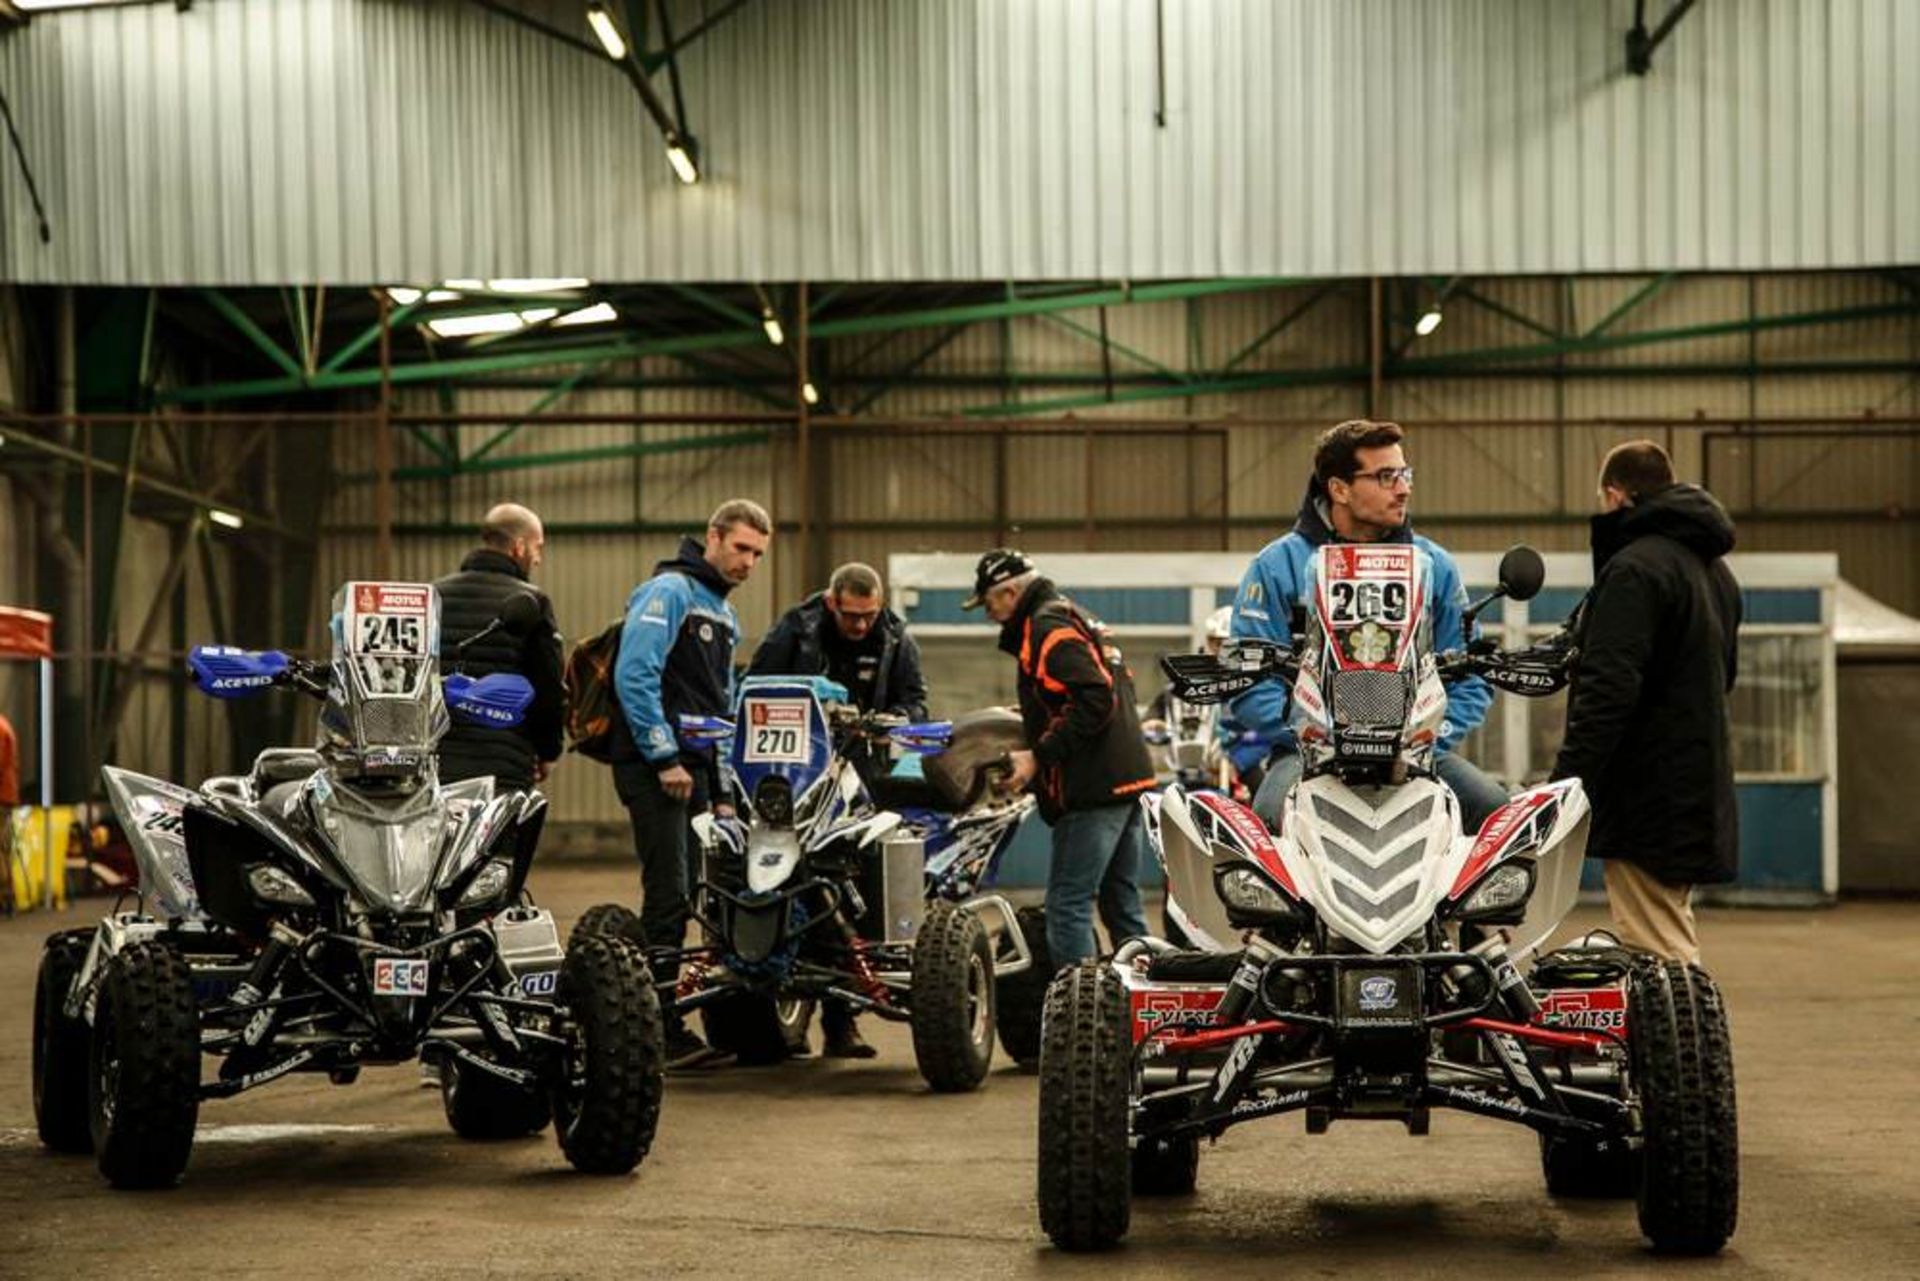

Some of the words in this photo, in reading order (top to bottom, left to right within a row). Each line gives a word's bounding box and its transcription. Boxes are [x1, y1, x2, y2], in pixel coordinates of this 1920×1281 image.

[1358, 556, 1408, 570] MOTUL
[1331, 581, 1407, 622] 269
[362, 616, 419, 656] 245
[1483, 668, 1555, 687] ACERBIS
[757, 729, 797, 754] 270
[1354, 743, 1394, 756] YAMAHA
[1567, 1010, 1624, 1029] VITSE
